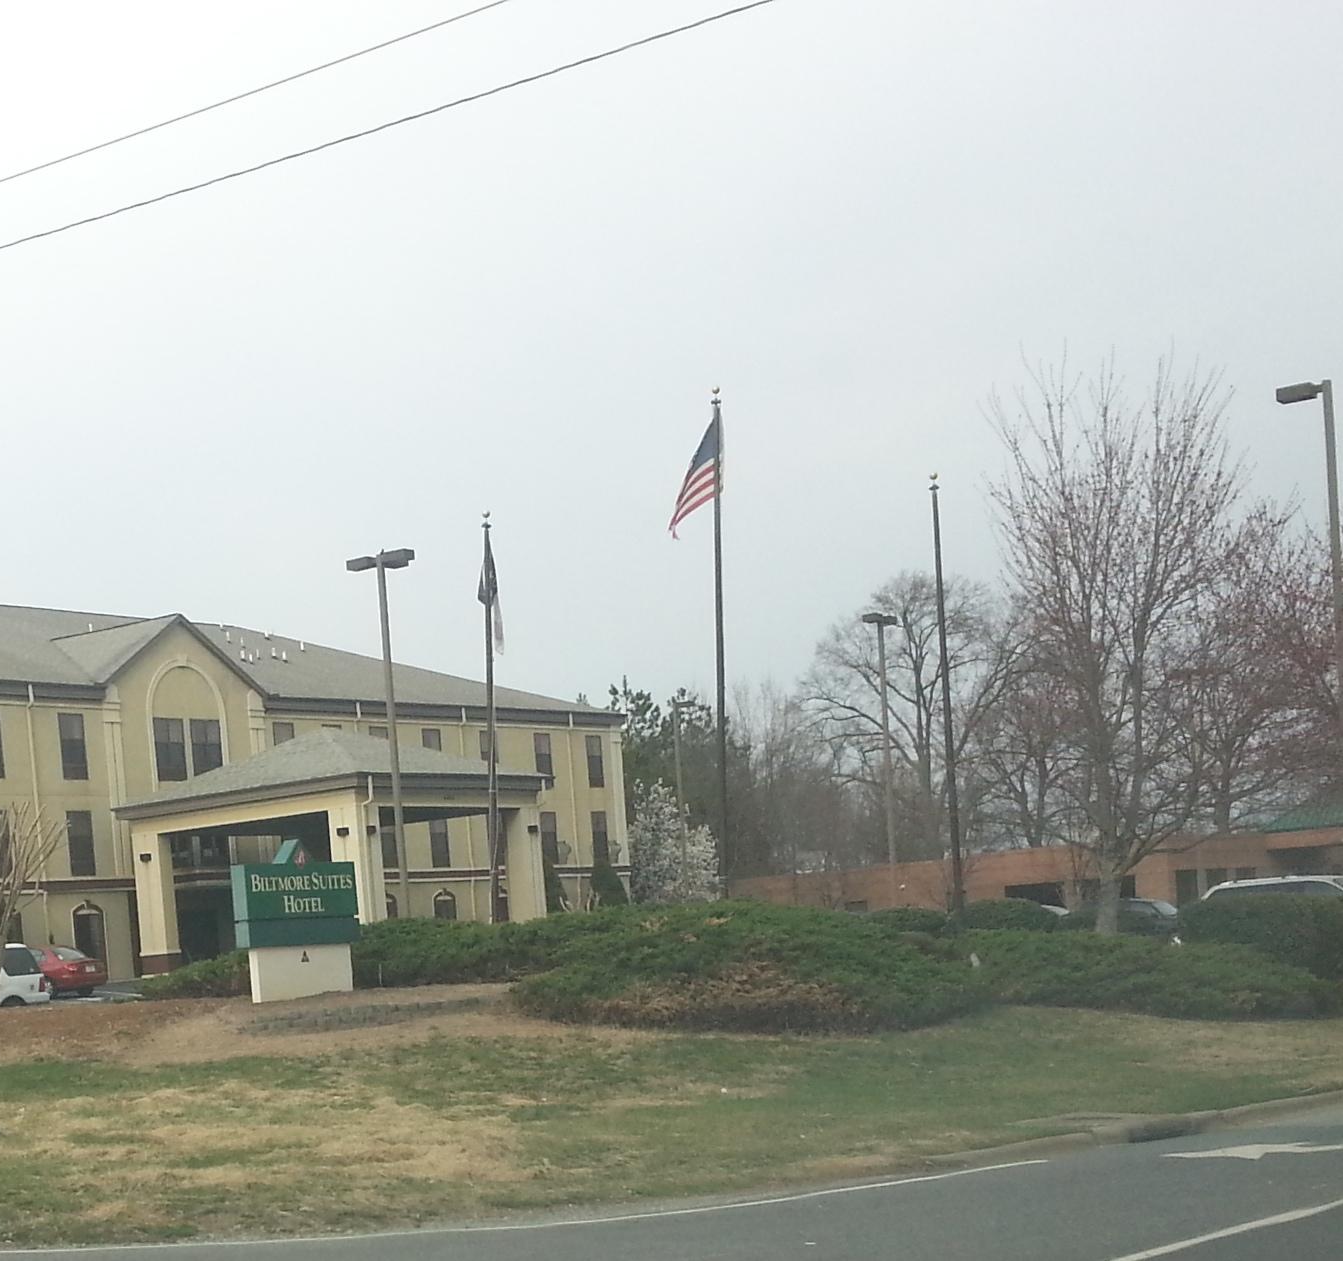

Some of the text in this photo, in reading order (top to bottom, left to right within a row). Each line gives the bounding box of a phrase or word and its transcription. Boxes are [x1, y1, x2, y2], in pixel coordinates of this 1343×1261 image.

[250, 872, 353, 892] BILTMORE SUITES
[283, 895, 325, 913] HOTEL
